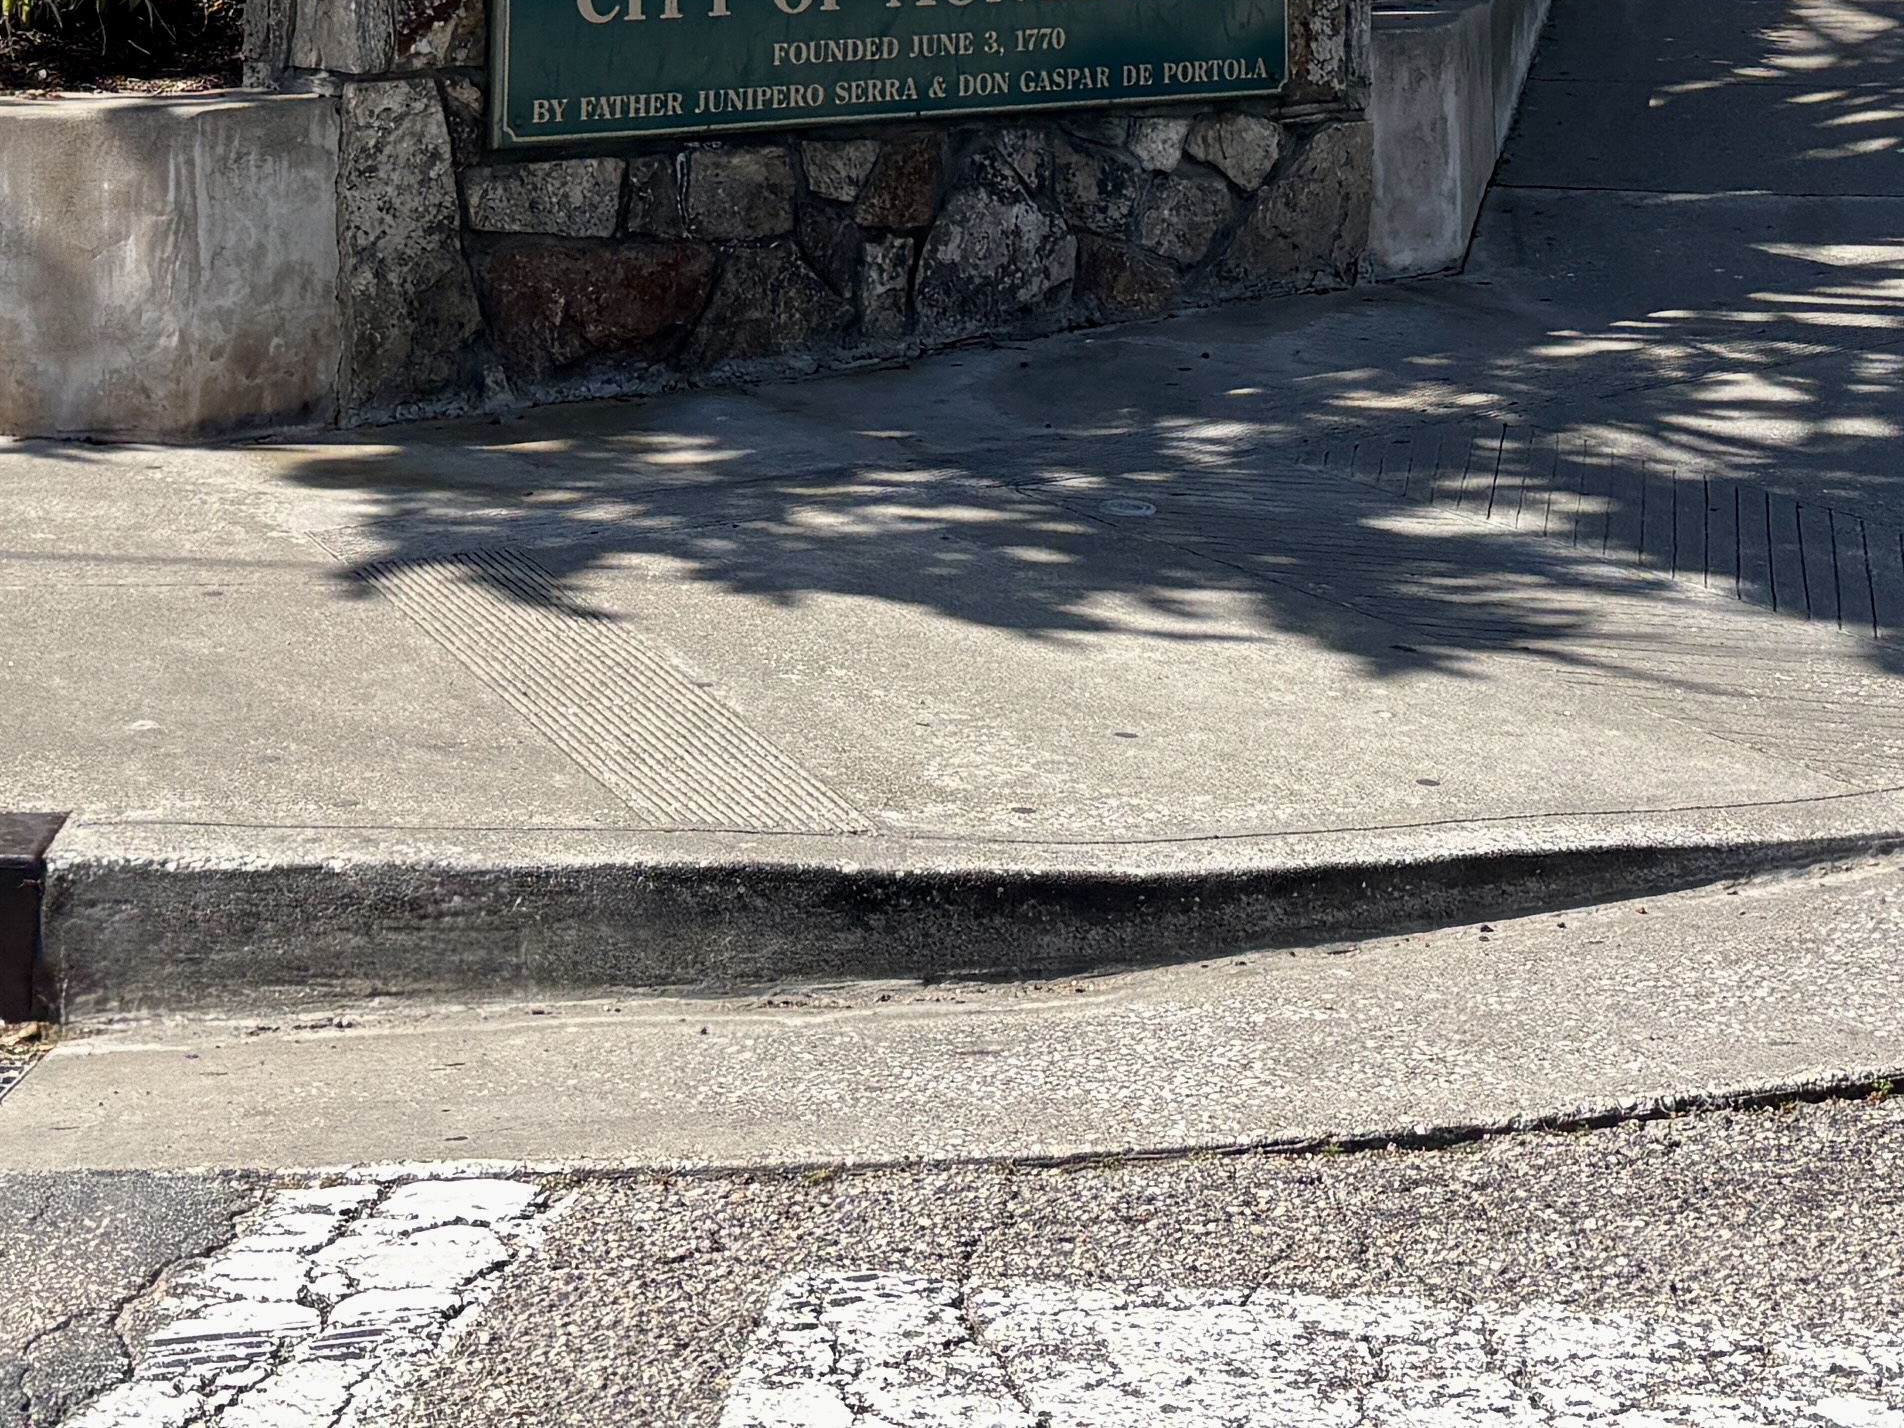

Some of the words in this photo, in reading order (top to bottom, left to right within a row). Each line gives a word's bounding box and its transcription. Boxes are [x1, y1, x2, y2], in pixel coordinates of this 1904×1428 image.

[772, 37, 900, 66] FOUNDED
[909, 33, 974, 58] JUNE
[984, 31, 1005, 57] 3,
[1015, 27, 1066, 52] 1770
[531, 98, 568, 124] BY
[579, 91, 684, 122] FATHER
[695, 84, 825, 114] JUNIPERO
[834, 76, 919, 105] SERRA
[928, 75, 947, 99] &
[958, 71, 1010, 98] DON
[1019, 66, 1110, 93] GASPAR
[1122, 63, 1153, 88] DE
[1162, 56, 1268, 85] PORTOLA
